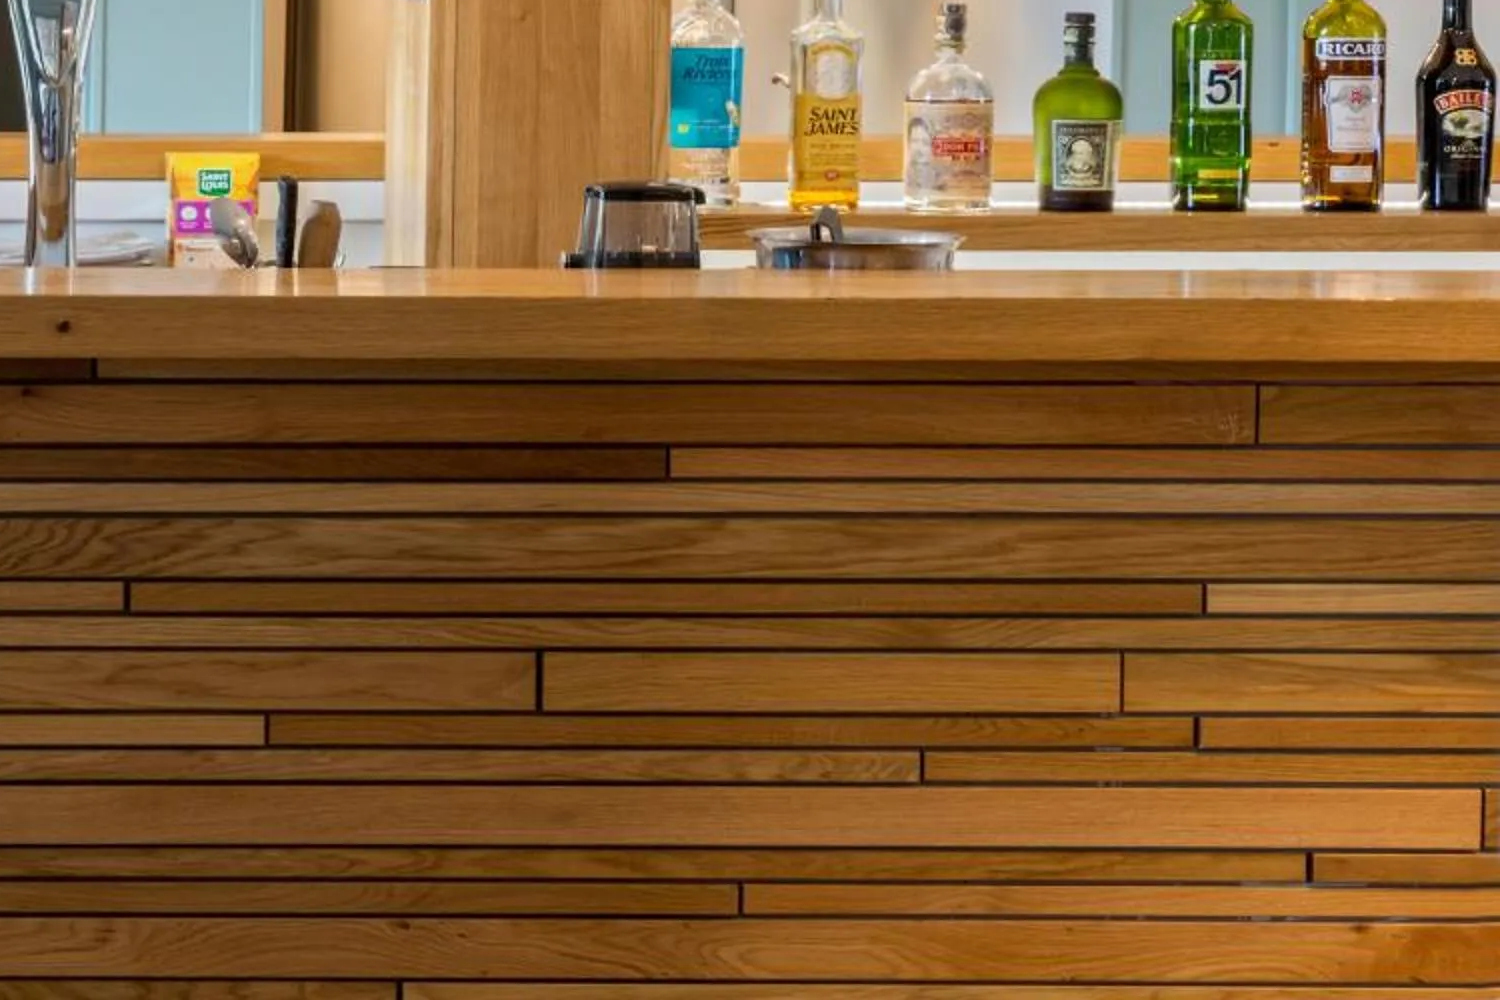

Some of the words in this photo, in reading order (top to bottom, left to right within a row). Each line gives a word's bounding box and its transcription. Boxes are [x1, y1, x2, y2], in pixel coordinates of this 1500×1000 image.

[1205, 69, 1242, 105] 51
[809, 107, 857, 122] SAINT
[804, 121, 859, 136] JAMES
